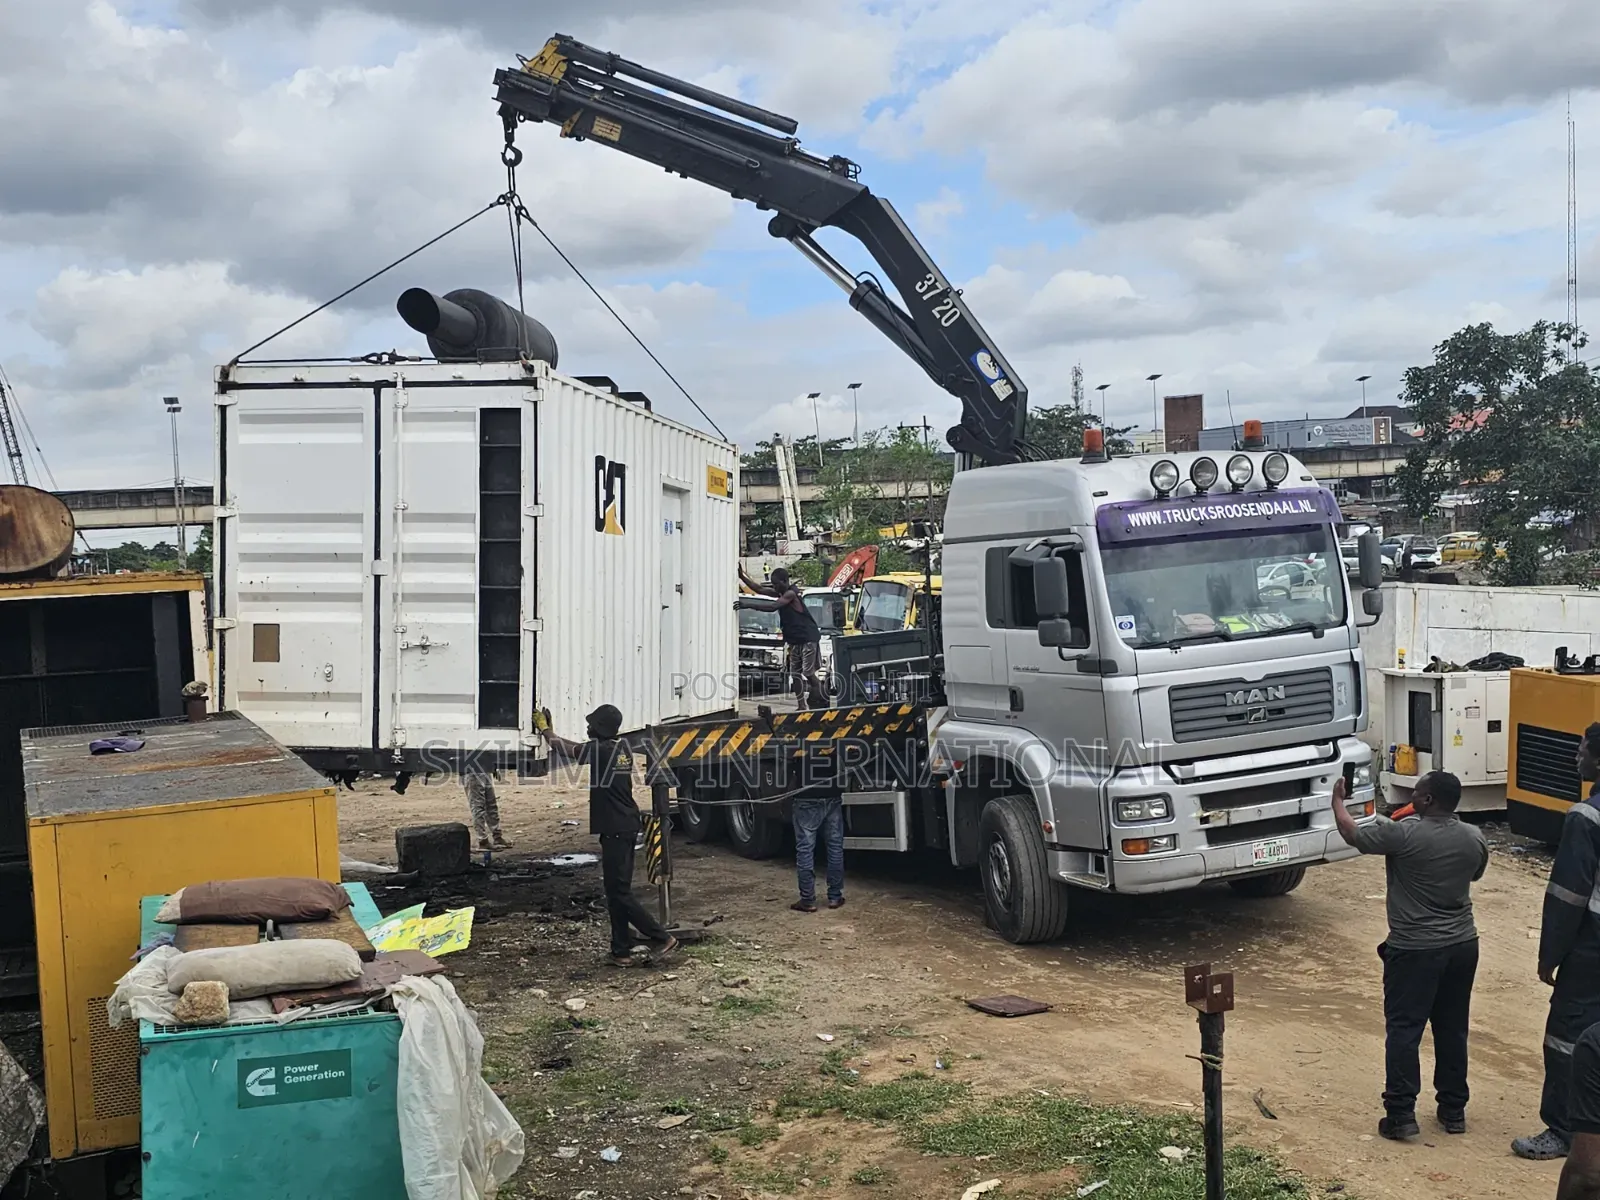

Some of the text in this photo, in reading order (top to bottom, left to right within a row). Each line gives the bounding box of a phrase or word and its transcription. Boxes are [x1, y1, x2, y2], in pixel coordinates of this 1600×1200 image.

[915, 273, 960, 327] 37 20
[594, 454, 626, 536] CAT
[1128, 500, 1316, 527] WWW.TRUCKSROOSENDAAL.NL
[1225, 685, 1286, 707] MAN
[283, 1063, 319, 1075] Power
[283, 1070, 346, 1084] Generation
